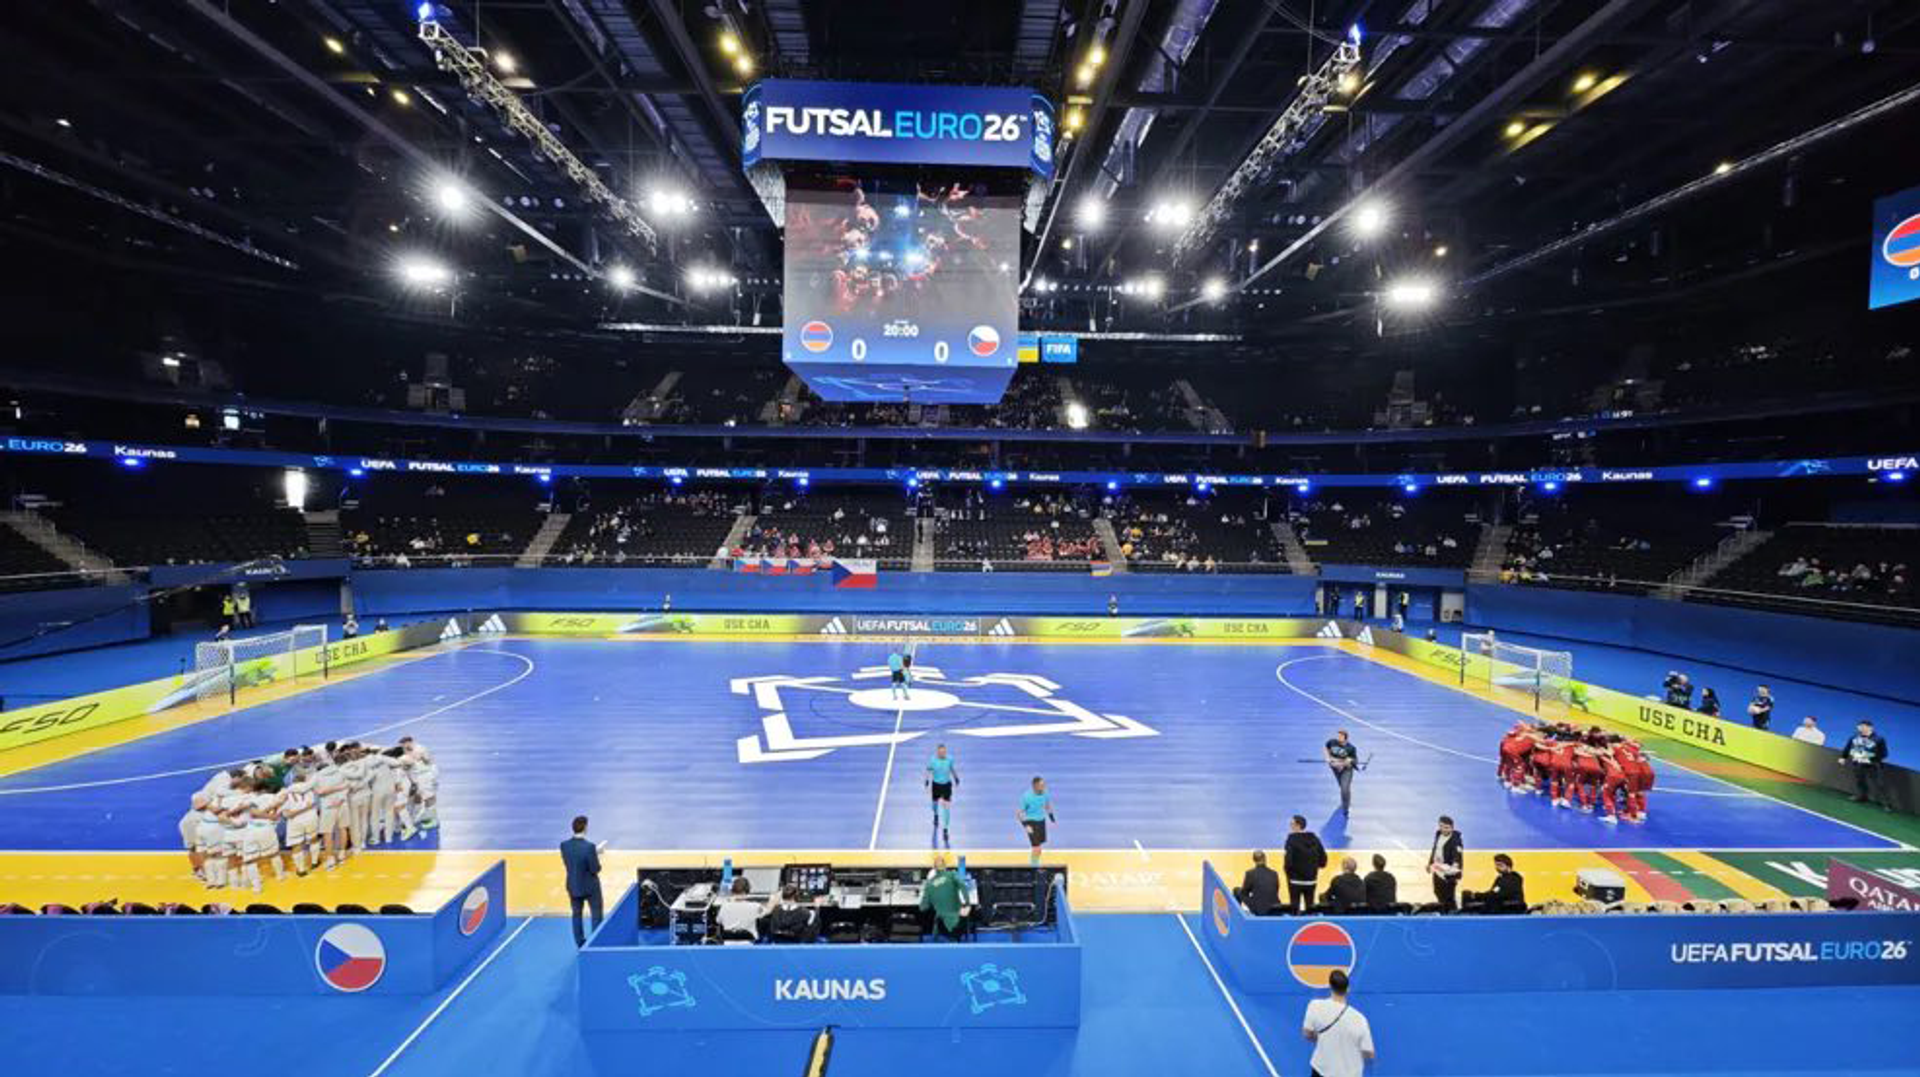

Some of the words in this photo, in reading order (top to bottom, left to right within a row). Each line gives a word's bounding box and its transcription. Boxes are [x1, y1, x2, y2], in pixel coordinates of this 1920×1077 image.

[883, 322, 920, 337] 20:00
[851, 338, 867, 361] 0
[934, 341, 950, 364] 0
[1046, 343, 1071, 355] FIFA
[114, 445, 176, 459] Kaunas
[361, 459, 396, 470] UEFA
[409, 461, 456, 472] FUTSAL
[1867, 457, 1919, 470] UEFA
[1437, 475, 1469, 485] UEFA
[1480, 473, 1528, 484] FUTSAL
[1602, 471, 1653, 481] Kaunas
[857, 619, 887, 631] UEFA
[1639, 705, 1676, 731] USE
[1682, 718, 1726, 746] CHA
[1671, 943, 1729, 964] UEFA
[1731, 942, 1818, 963] FUTSAL
[775, 978, 886, 1001] KAUNAS
